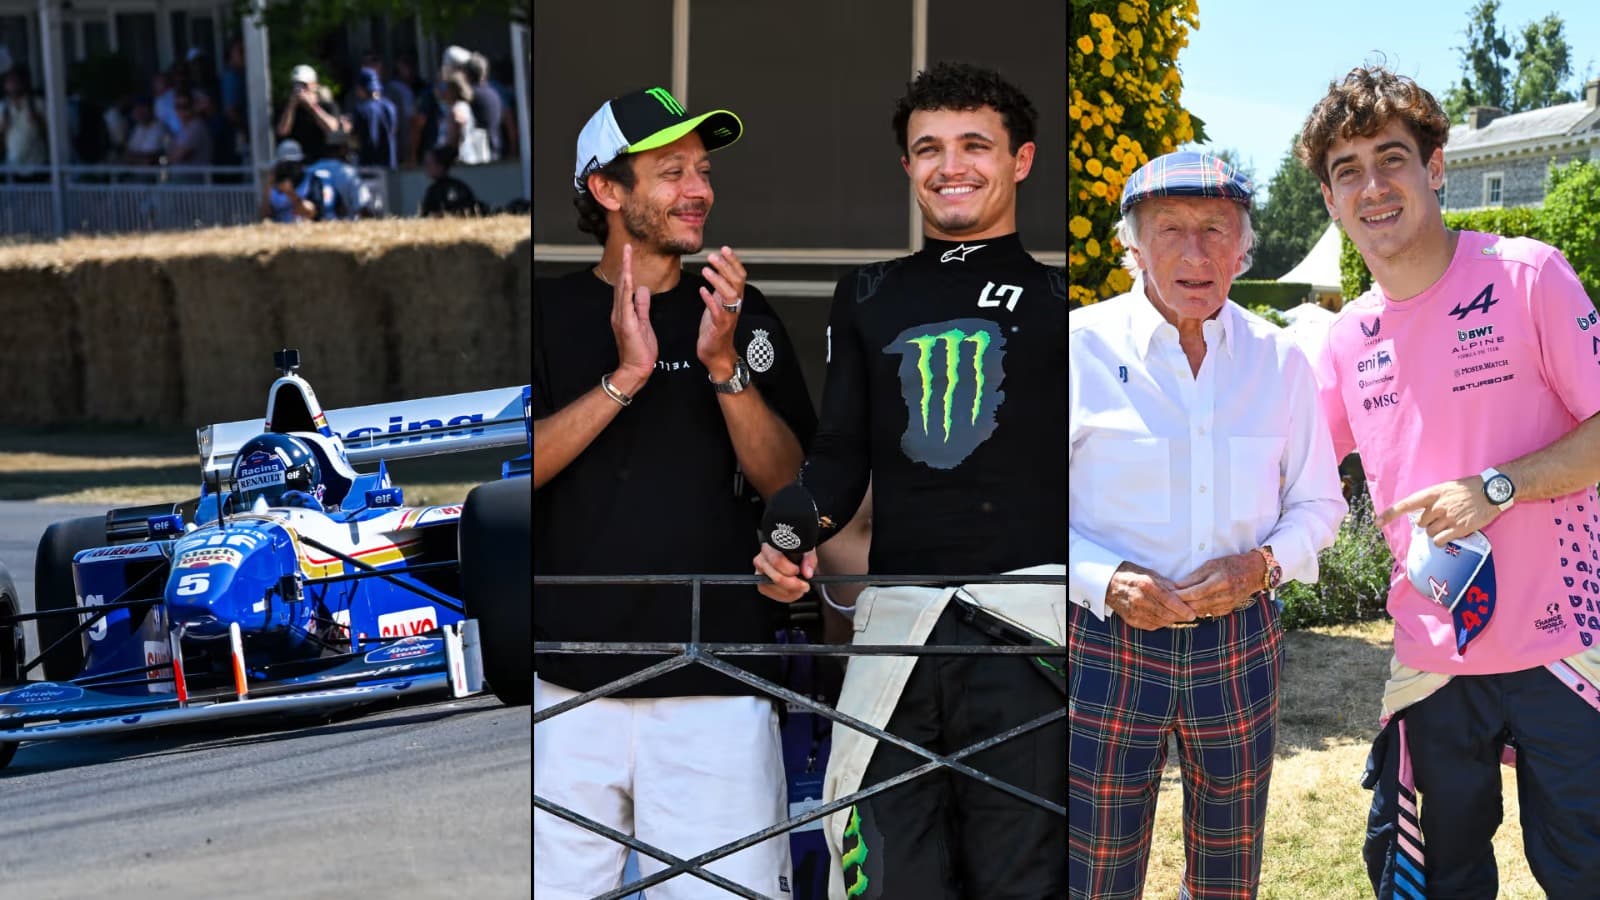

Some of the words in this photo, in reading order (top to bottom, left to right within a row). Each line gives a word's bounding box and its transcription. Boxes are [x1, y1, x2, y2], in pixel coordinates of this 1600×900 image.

[1468, 326, 1493, 339] BWT
[1451, 336, 1505, 353] ALPINE
[1357, 354, 1376, 373] eni
[1373, 392, 1399, 409] MSC
[241, 464, 279, 477] Racing
[240, 472, 281, 489] RENAULT
[374, 493, 393, 505] elf
[153, 520, 170, 531] elf
[176, 572, 211, 596] 5
